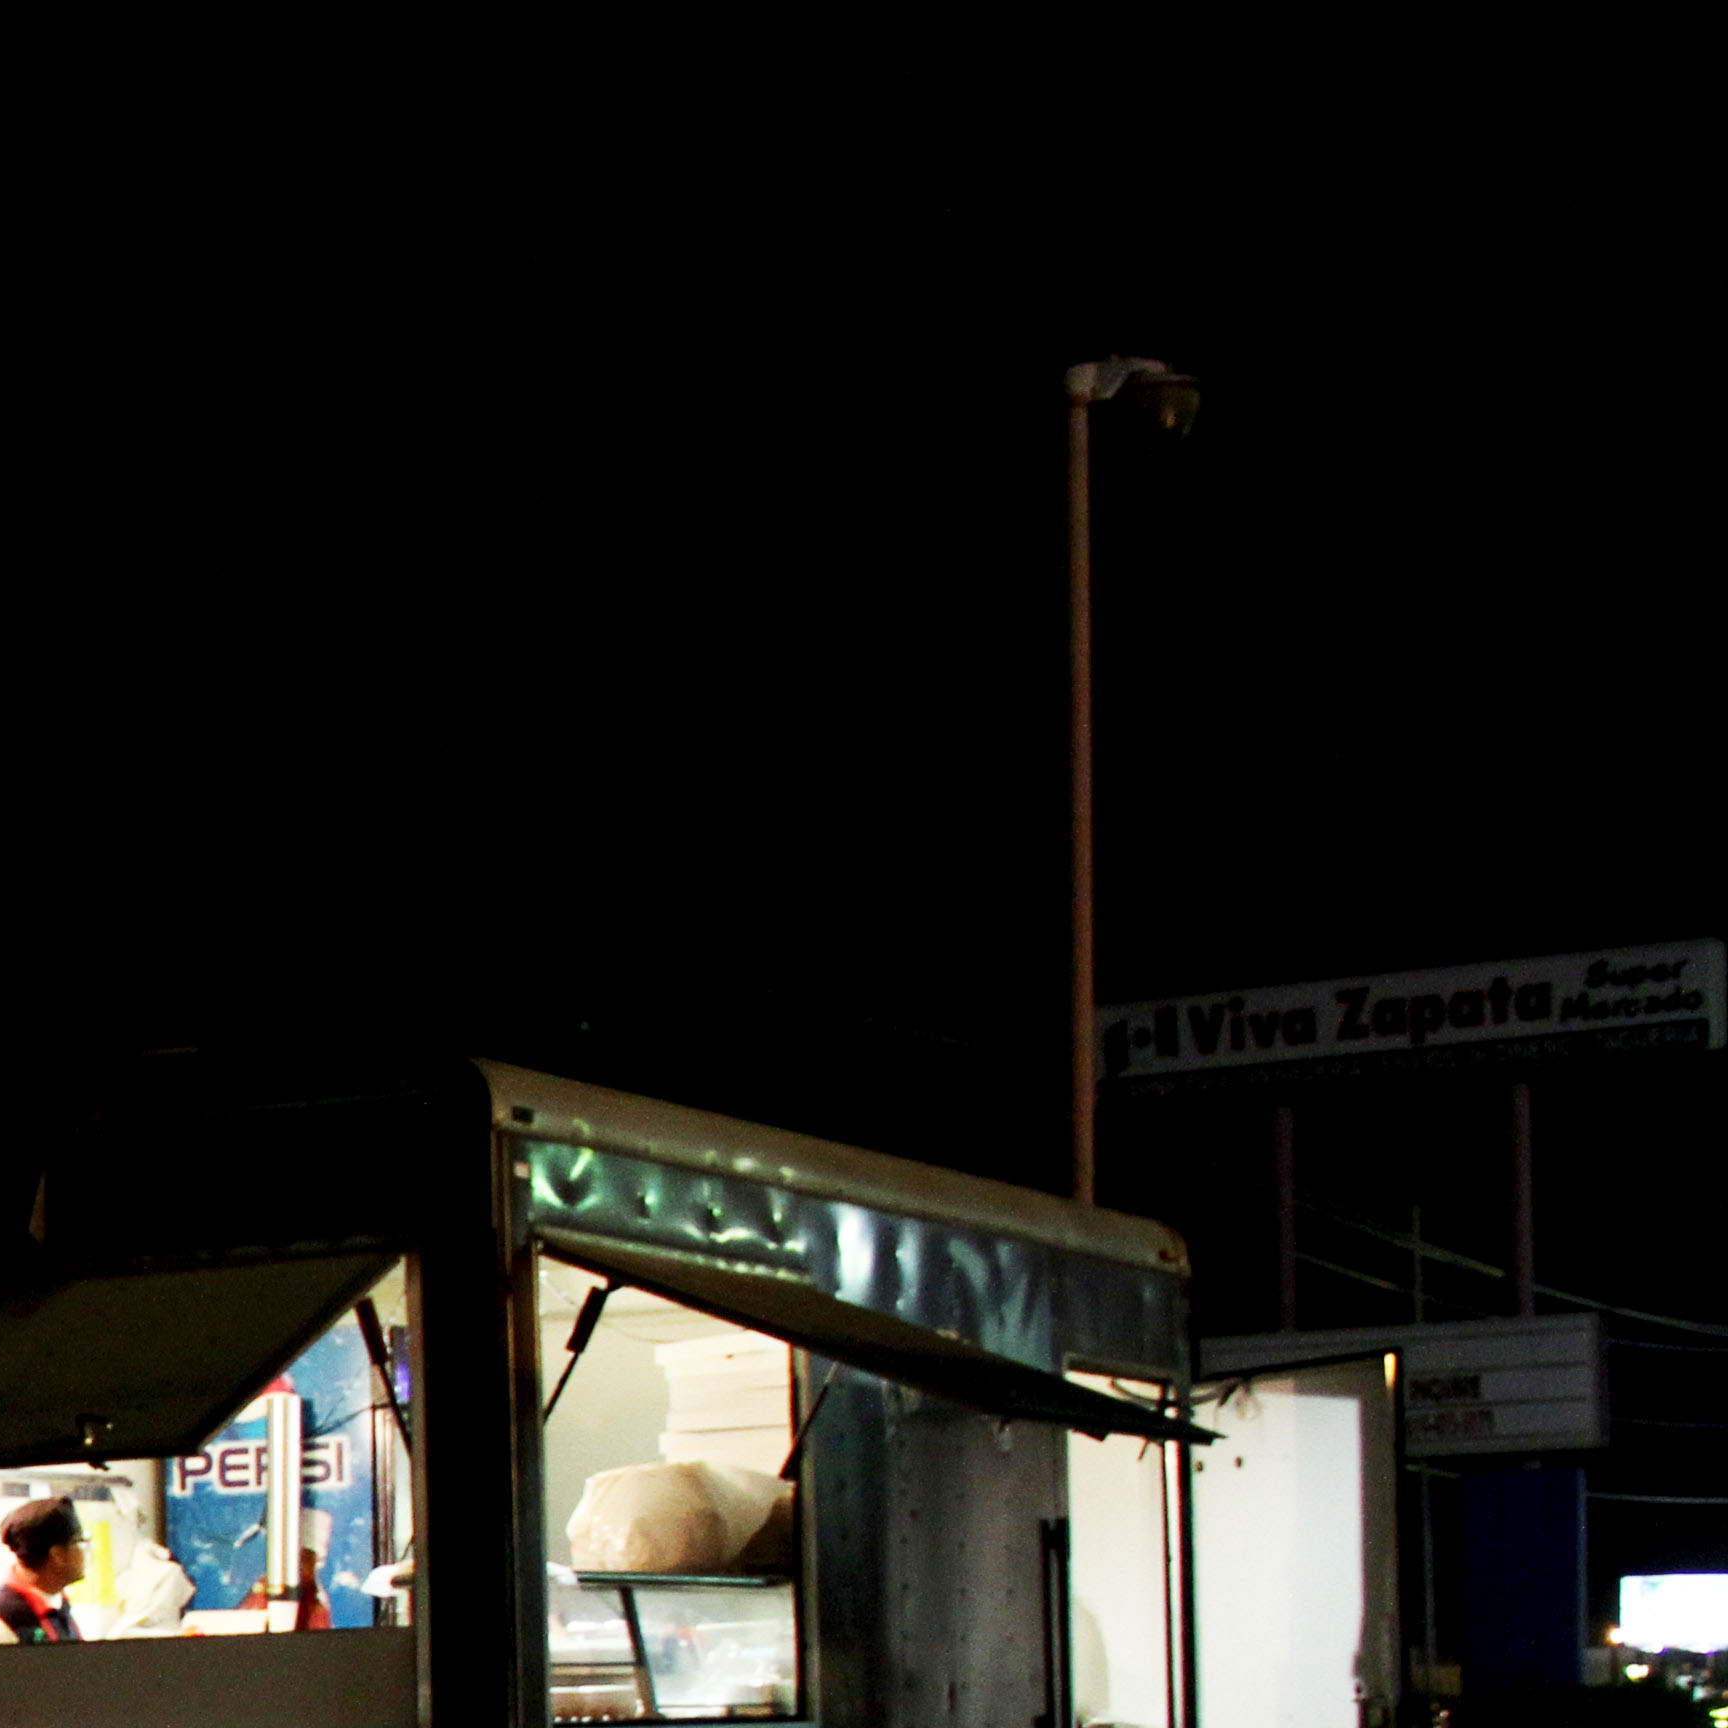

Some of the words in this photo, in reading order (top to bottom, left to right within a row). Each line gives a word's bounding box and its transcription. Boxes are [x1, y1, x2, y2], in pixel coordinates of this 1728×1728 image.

[1585, 958, 1687, 988] Super
[1189, 996, 1316, 1054] Viva
[1335, 977, 1551, 1045] Zapata
[1561, 985, 1703, 1022] Mercado
